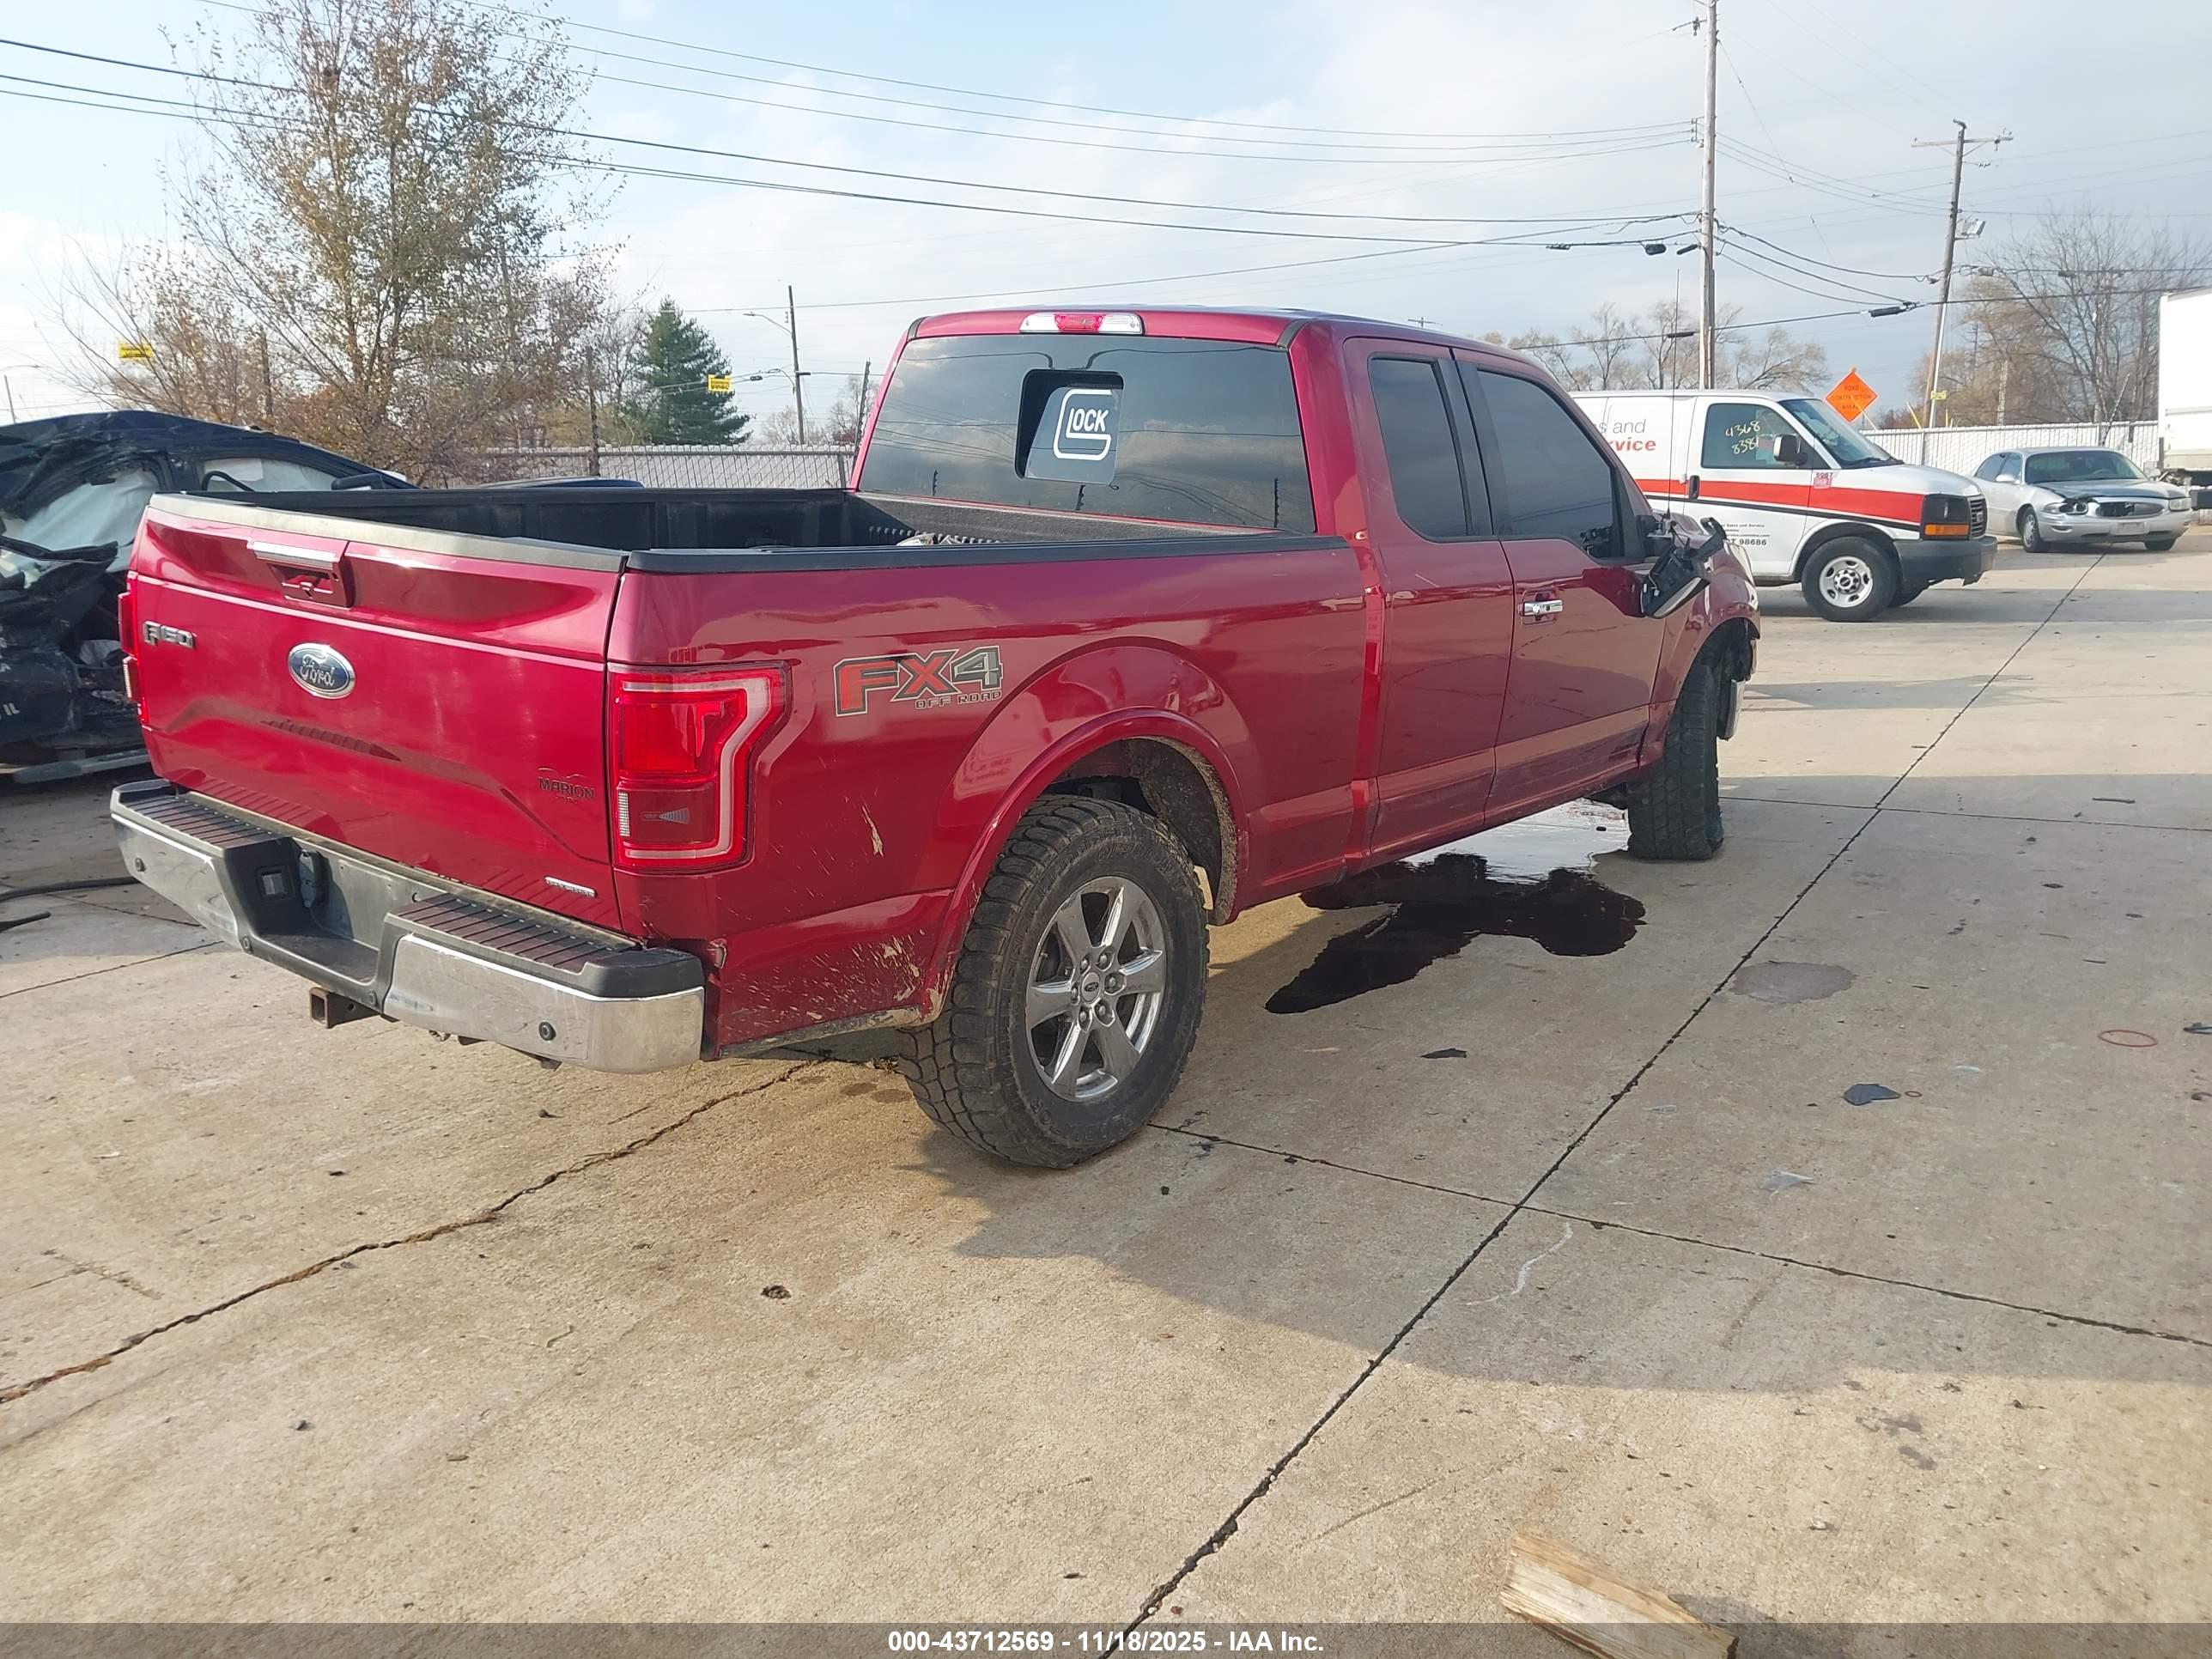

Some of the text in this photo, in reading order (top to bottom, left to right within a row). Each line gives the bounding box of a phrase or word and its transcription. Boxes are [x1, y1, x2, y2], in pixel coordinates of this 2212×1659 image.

[1613, 418, 1646, 434] and
[1725, 420, 1760, 437] 4368
[833, 645, 1004, 718] FX4
[915, 690, 1003, 709] OFF ROAD
[538, 776, 595, 800] MARION
